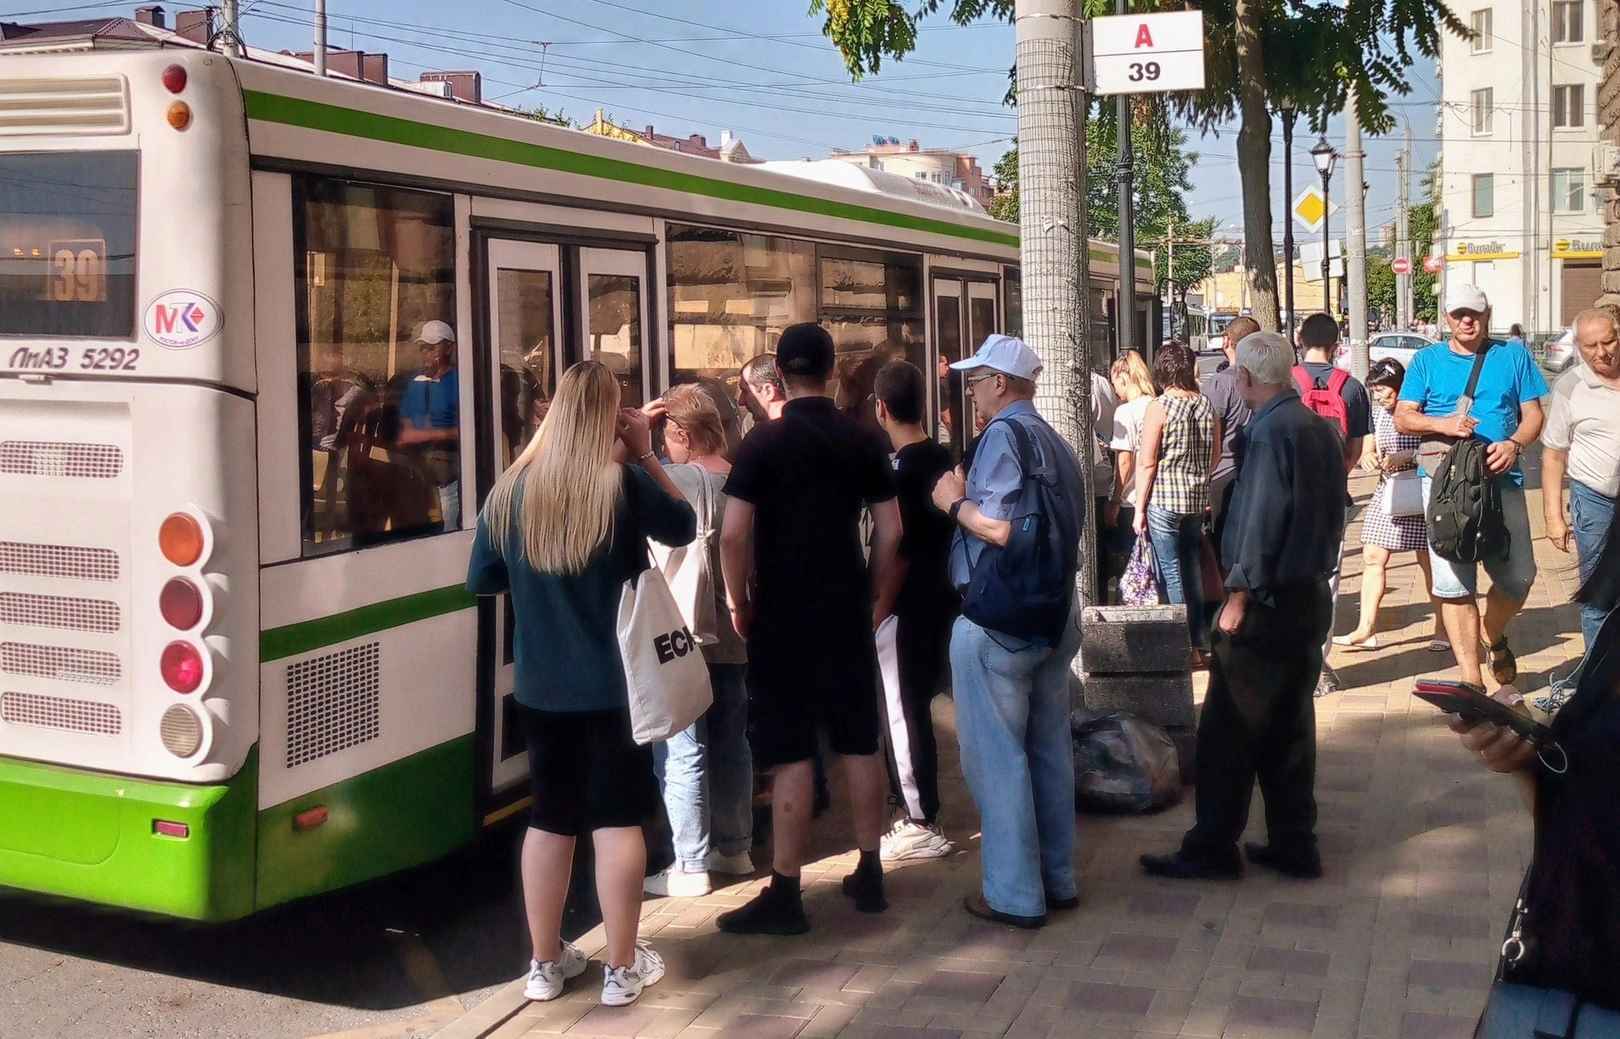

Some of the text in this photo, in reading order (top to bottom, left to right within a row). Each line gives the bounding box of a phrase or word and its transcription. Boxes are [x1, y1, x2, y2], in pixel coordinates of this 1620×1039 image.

[1135, 24, 1153, 48] А
[1128, 62, 1161, 81] 39
[54, 249, 98, 301] 39
[80, 348, 140, 370] 5292
